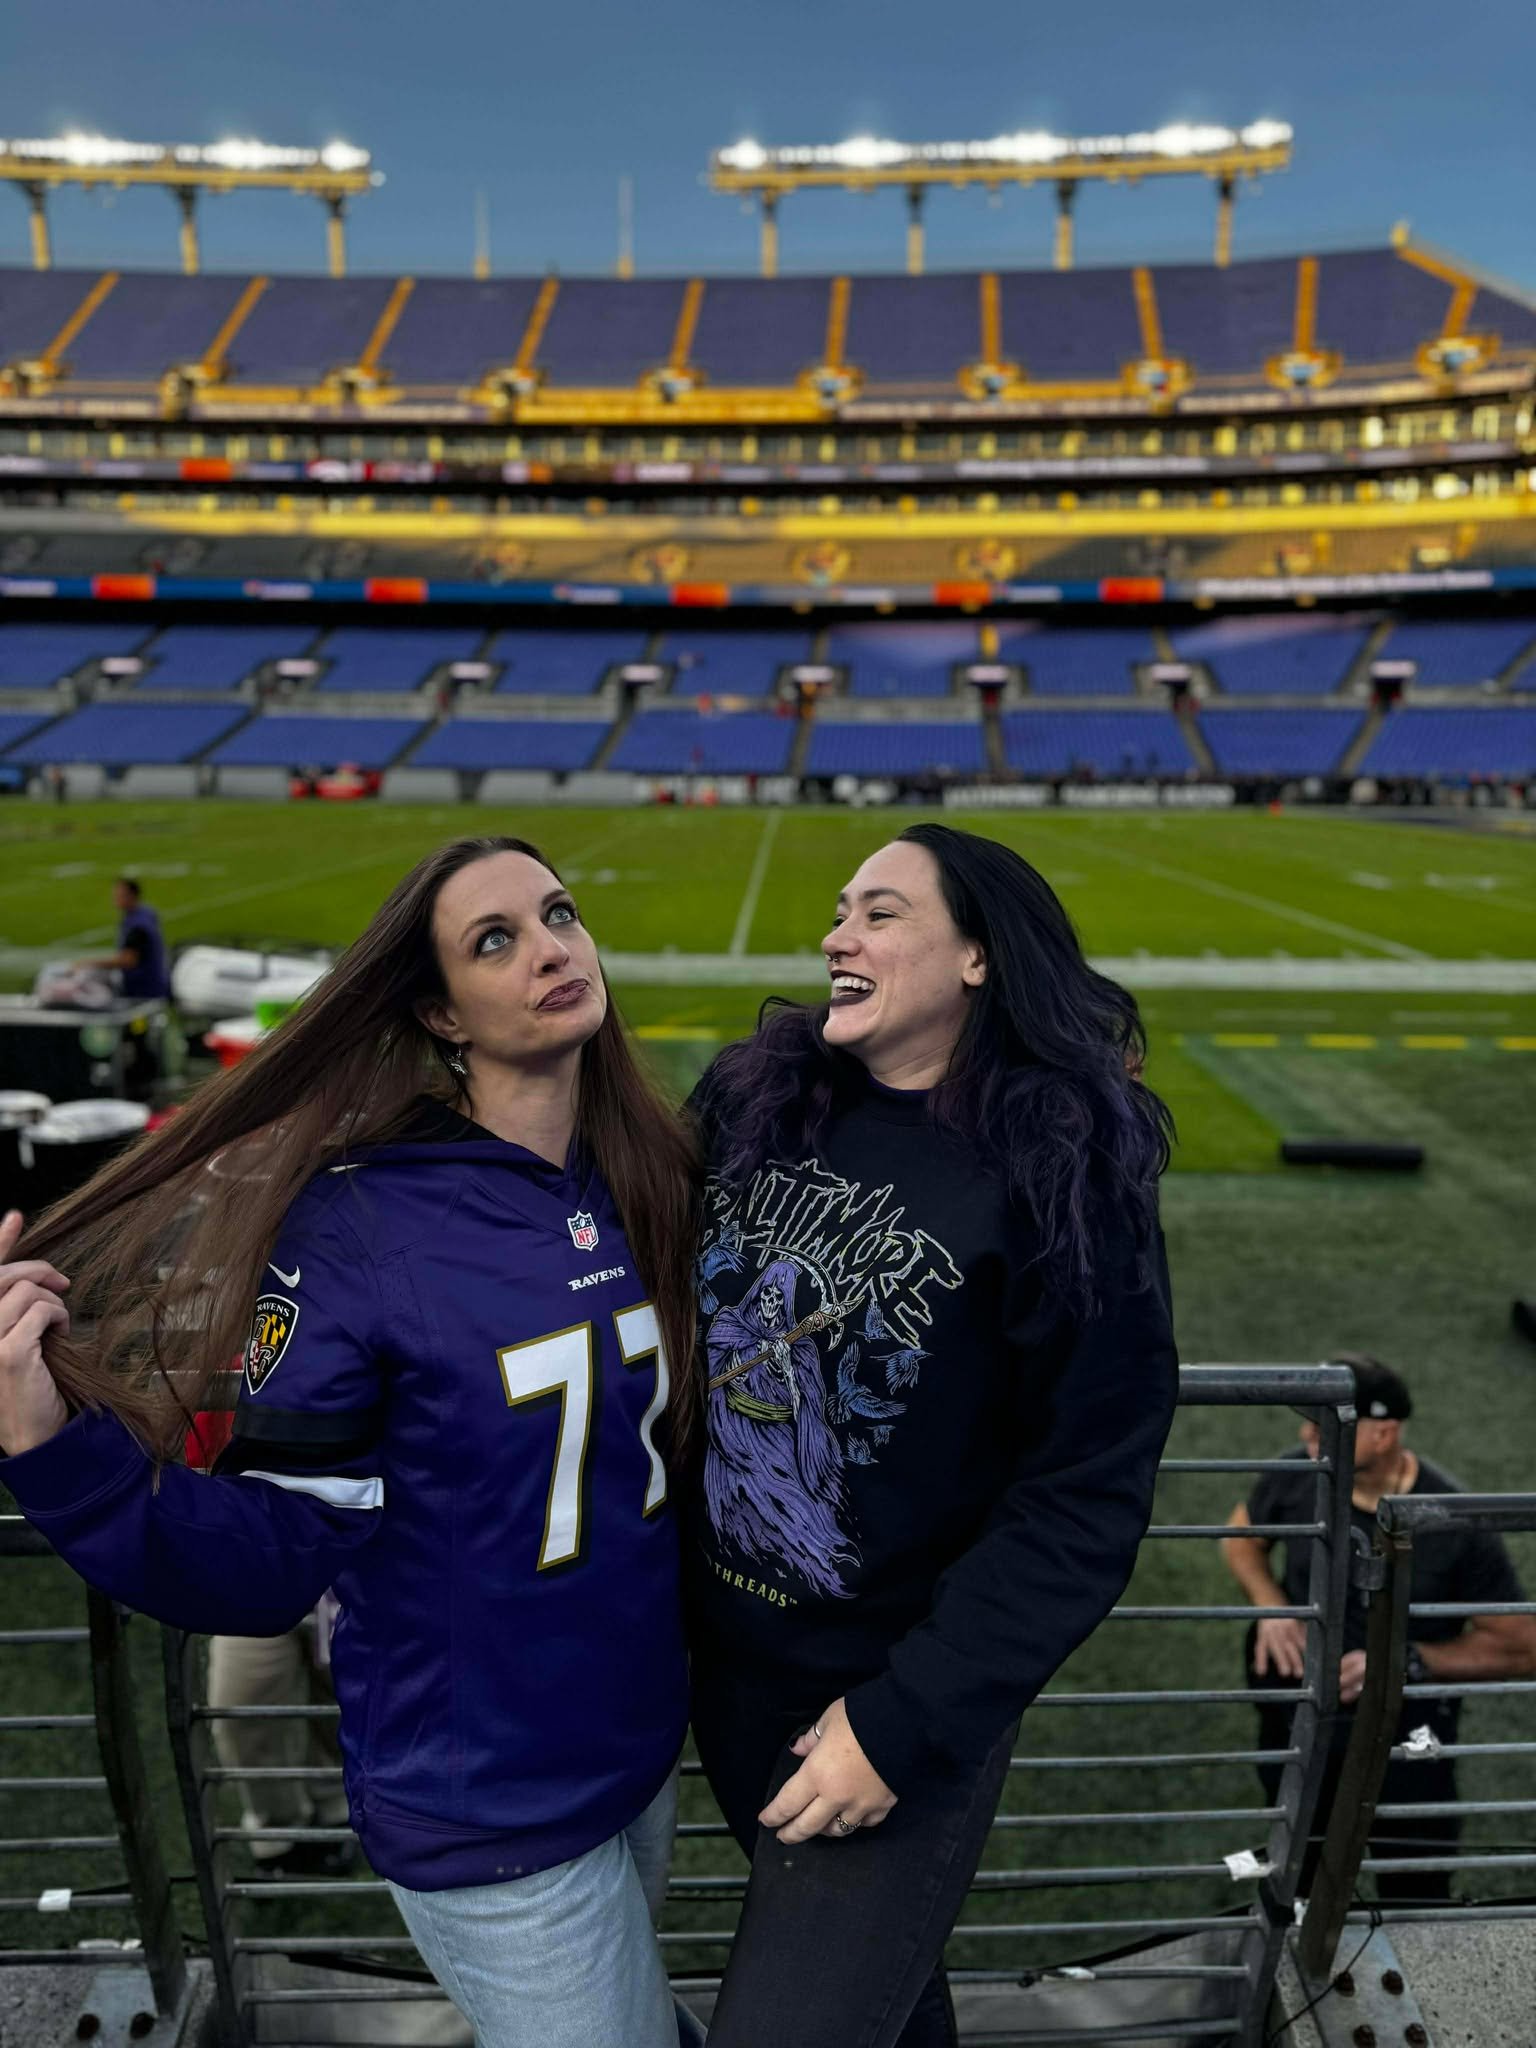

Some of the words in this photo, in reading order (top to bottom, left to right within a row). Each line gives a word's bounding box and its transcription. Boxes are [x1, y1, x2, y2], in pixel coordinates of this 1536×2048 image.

[575, 1227, 597, 1246] NFL
[567, 1266, 626, 1291] RAVENS
[257, 1302, 290, 1317] RAVENS
